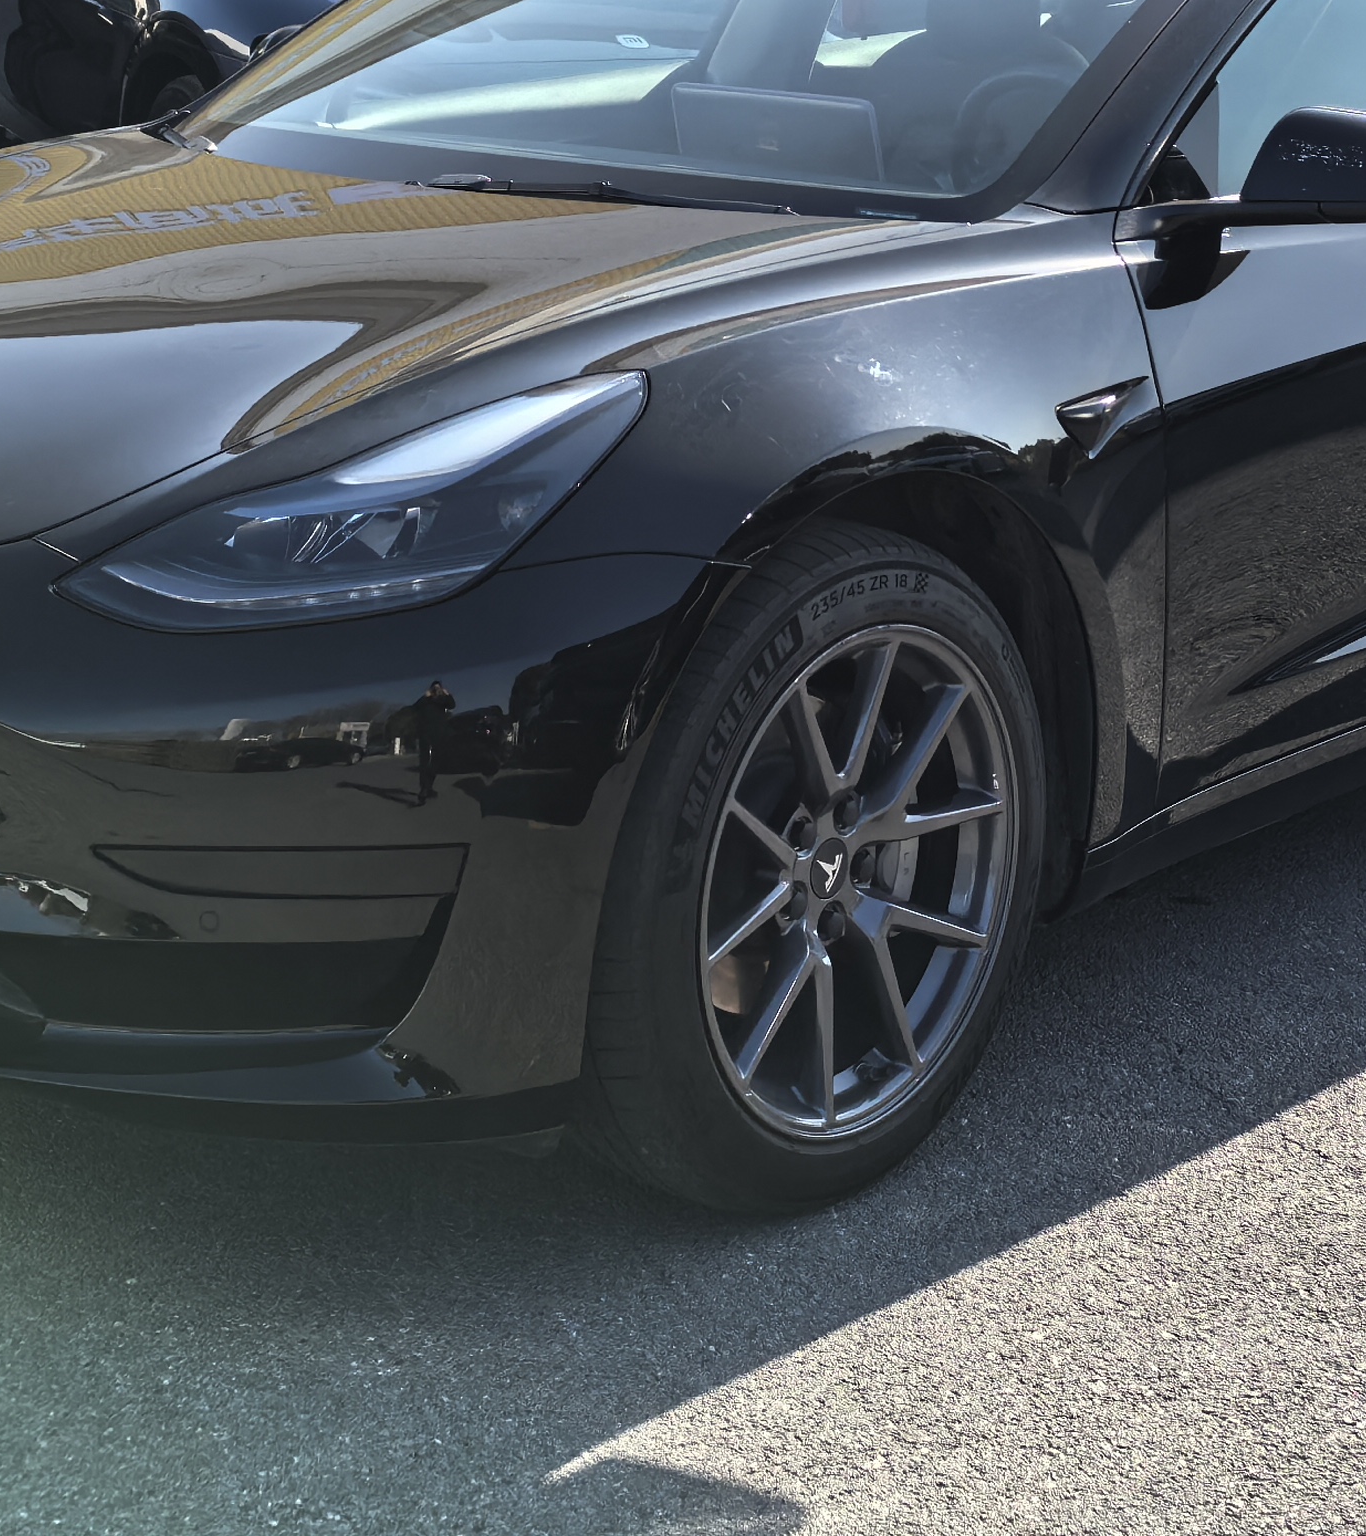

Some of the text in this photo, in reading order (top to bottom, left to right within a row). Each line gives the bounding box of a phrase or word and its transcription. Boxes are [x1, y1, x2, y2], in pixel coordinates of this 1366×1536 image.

[810, 578, 866, 621] 235/45
[870, 574, 889, 592] ZR
[895, 573, 908, 589] 18
